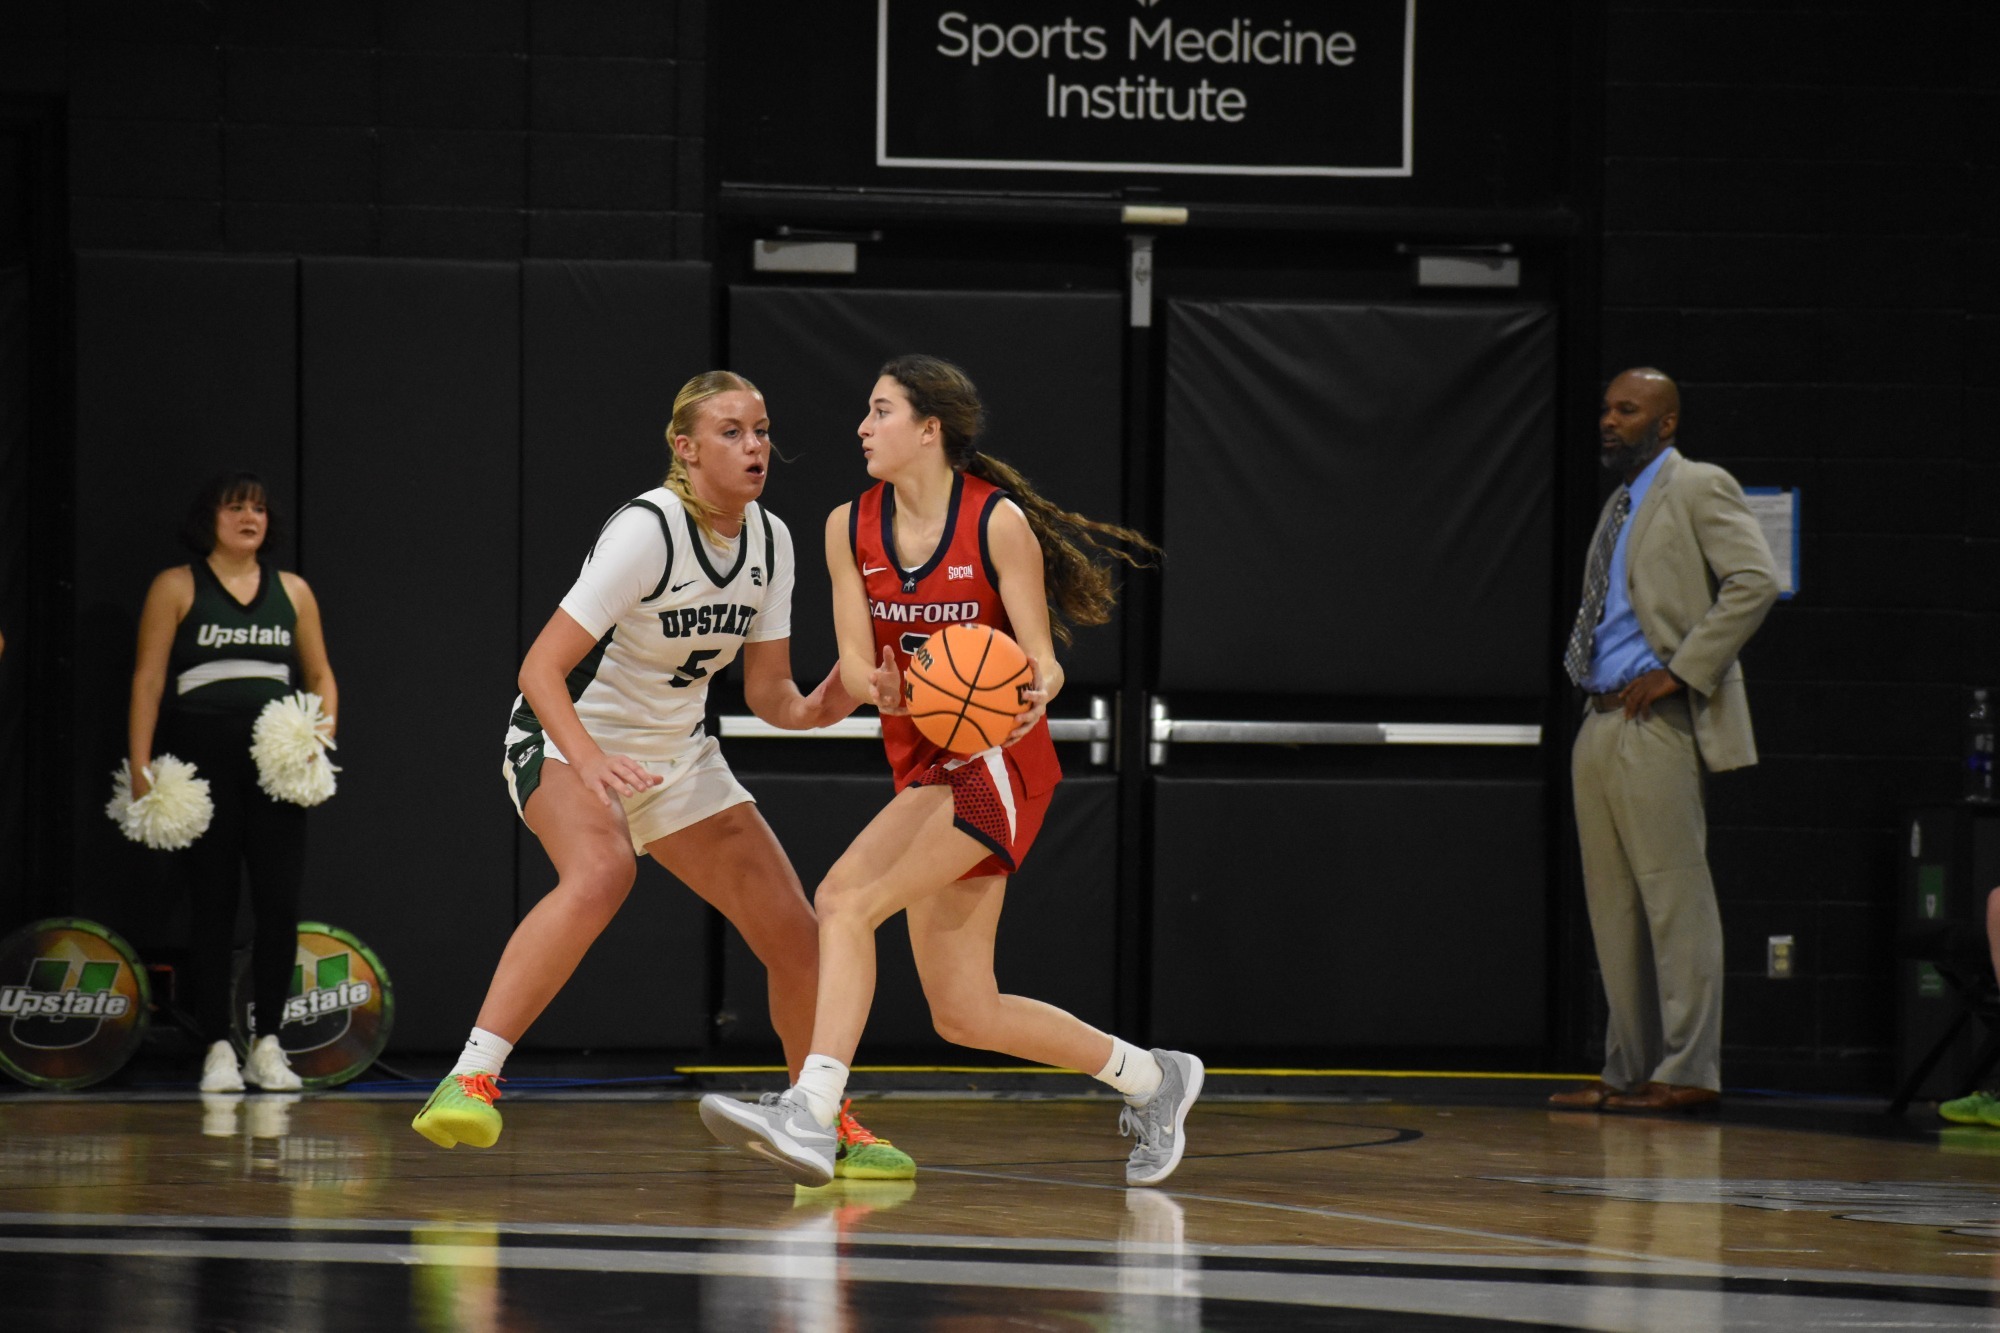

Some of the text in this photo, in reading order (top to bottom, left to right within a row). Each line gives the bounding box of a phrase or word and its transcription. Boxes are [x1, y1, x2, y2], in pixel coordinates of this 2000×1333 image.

[936, 12, 1357, 66] Sports Medicine
[1046, 74, 1248, 122] Institute
[197, 624, 292, 649] Upstate
[668, 649, 722, 688] 5
[0, 988, 128, 1017] Upstate
